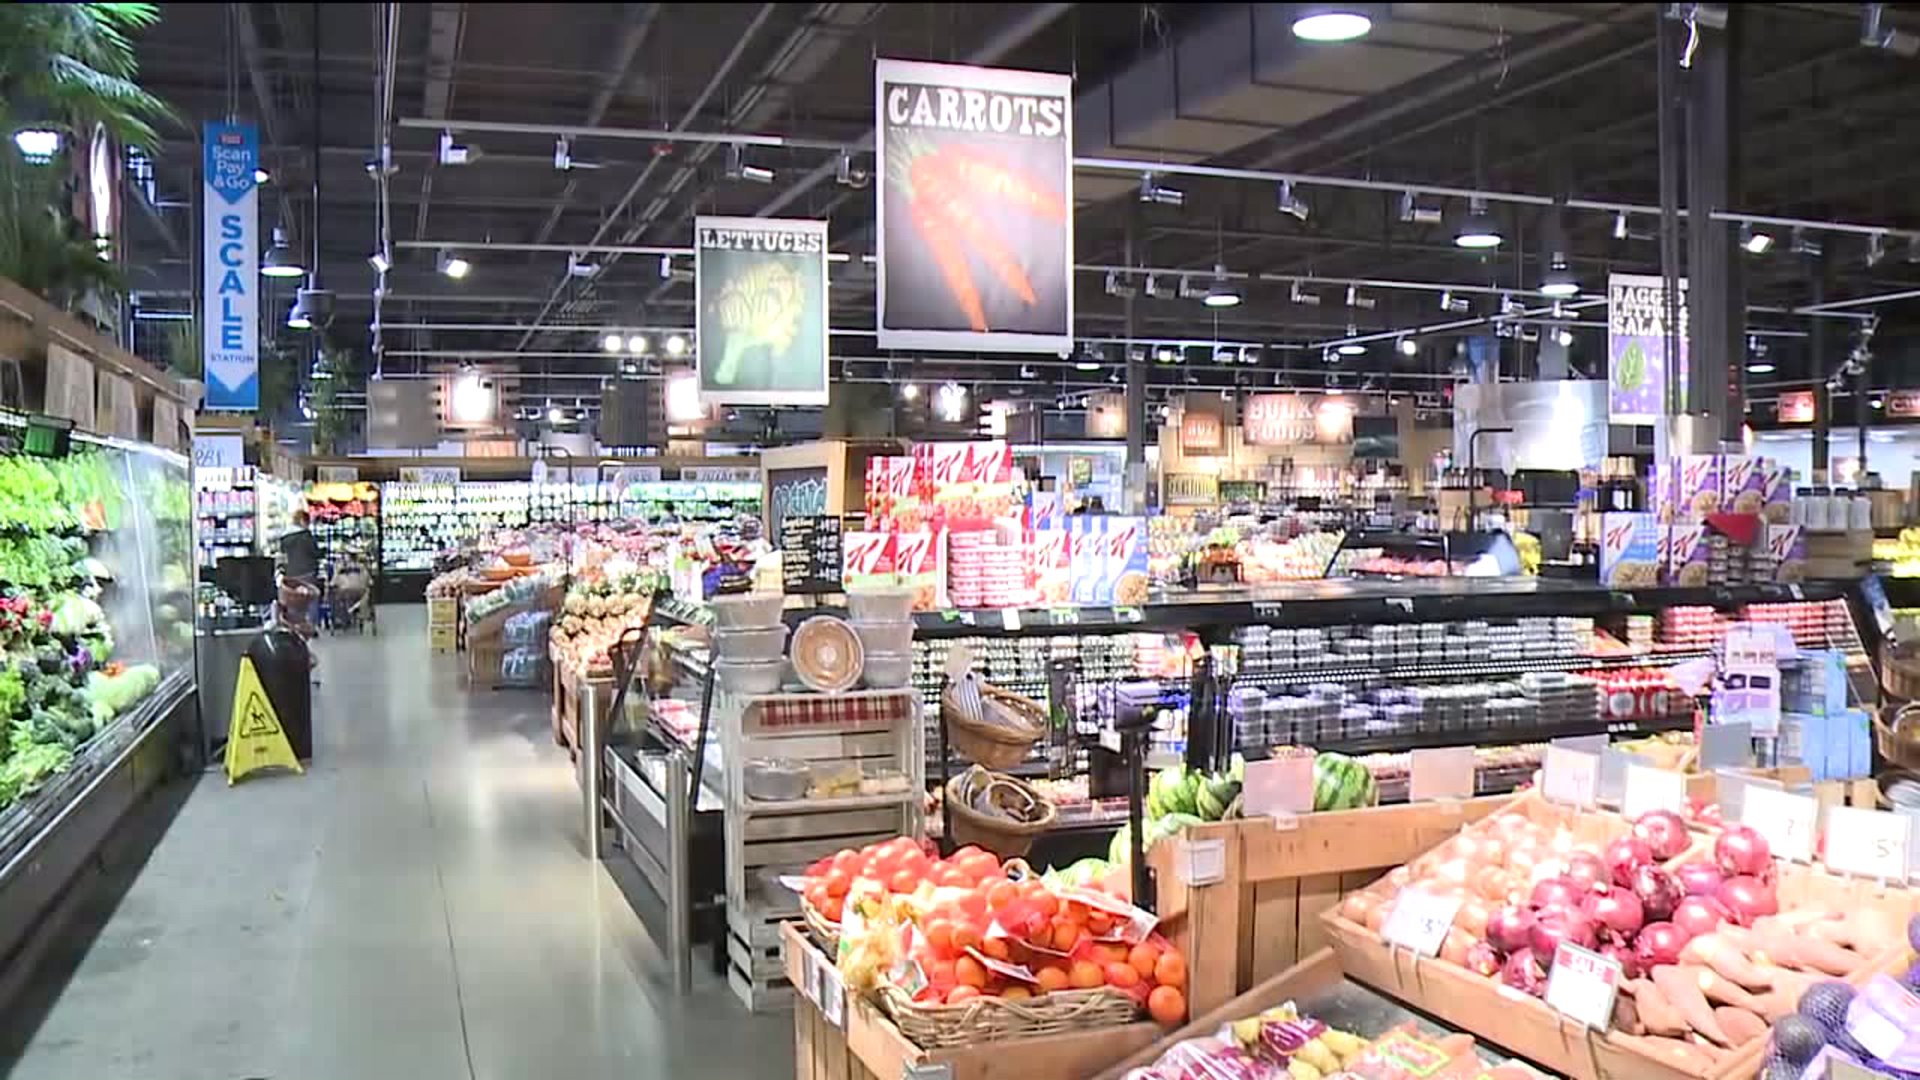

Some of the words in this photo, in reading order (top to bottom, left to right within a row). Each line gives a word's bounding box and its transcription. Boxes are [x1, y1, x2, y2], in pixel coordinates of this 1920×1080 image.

[888, 86, 1064, 138] CARROTS
[212, 144, 252, 161] Scan
[217, 160, 246, 178] Pay
[701, 229, 821, 253] LETTUCES
[218, 214, 245, 350] SCALE
[210, 353, 254, 365] STATION
